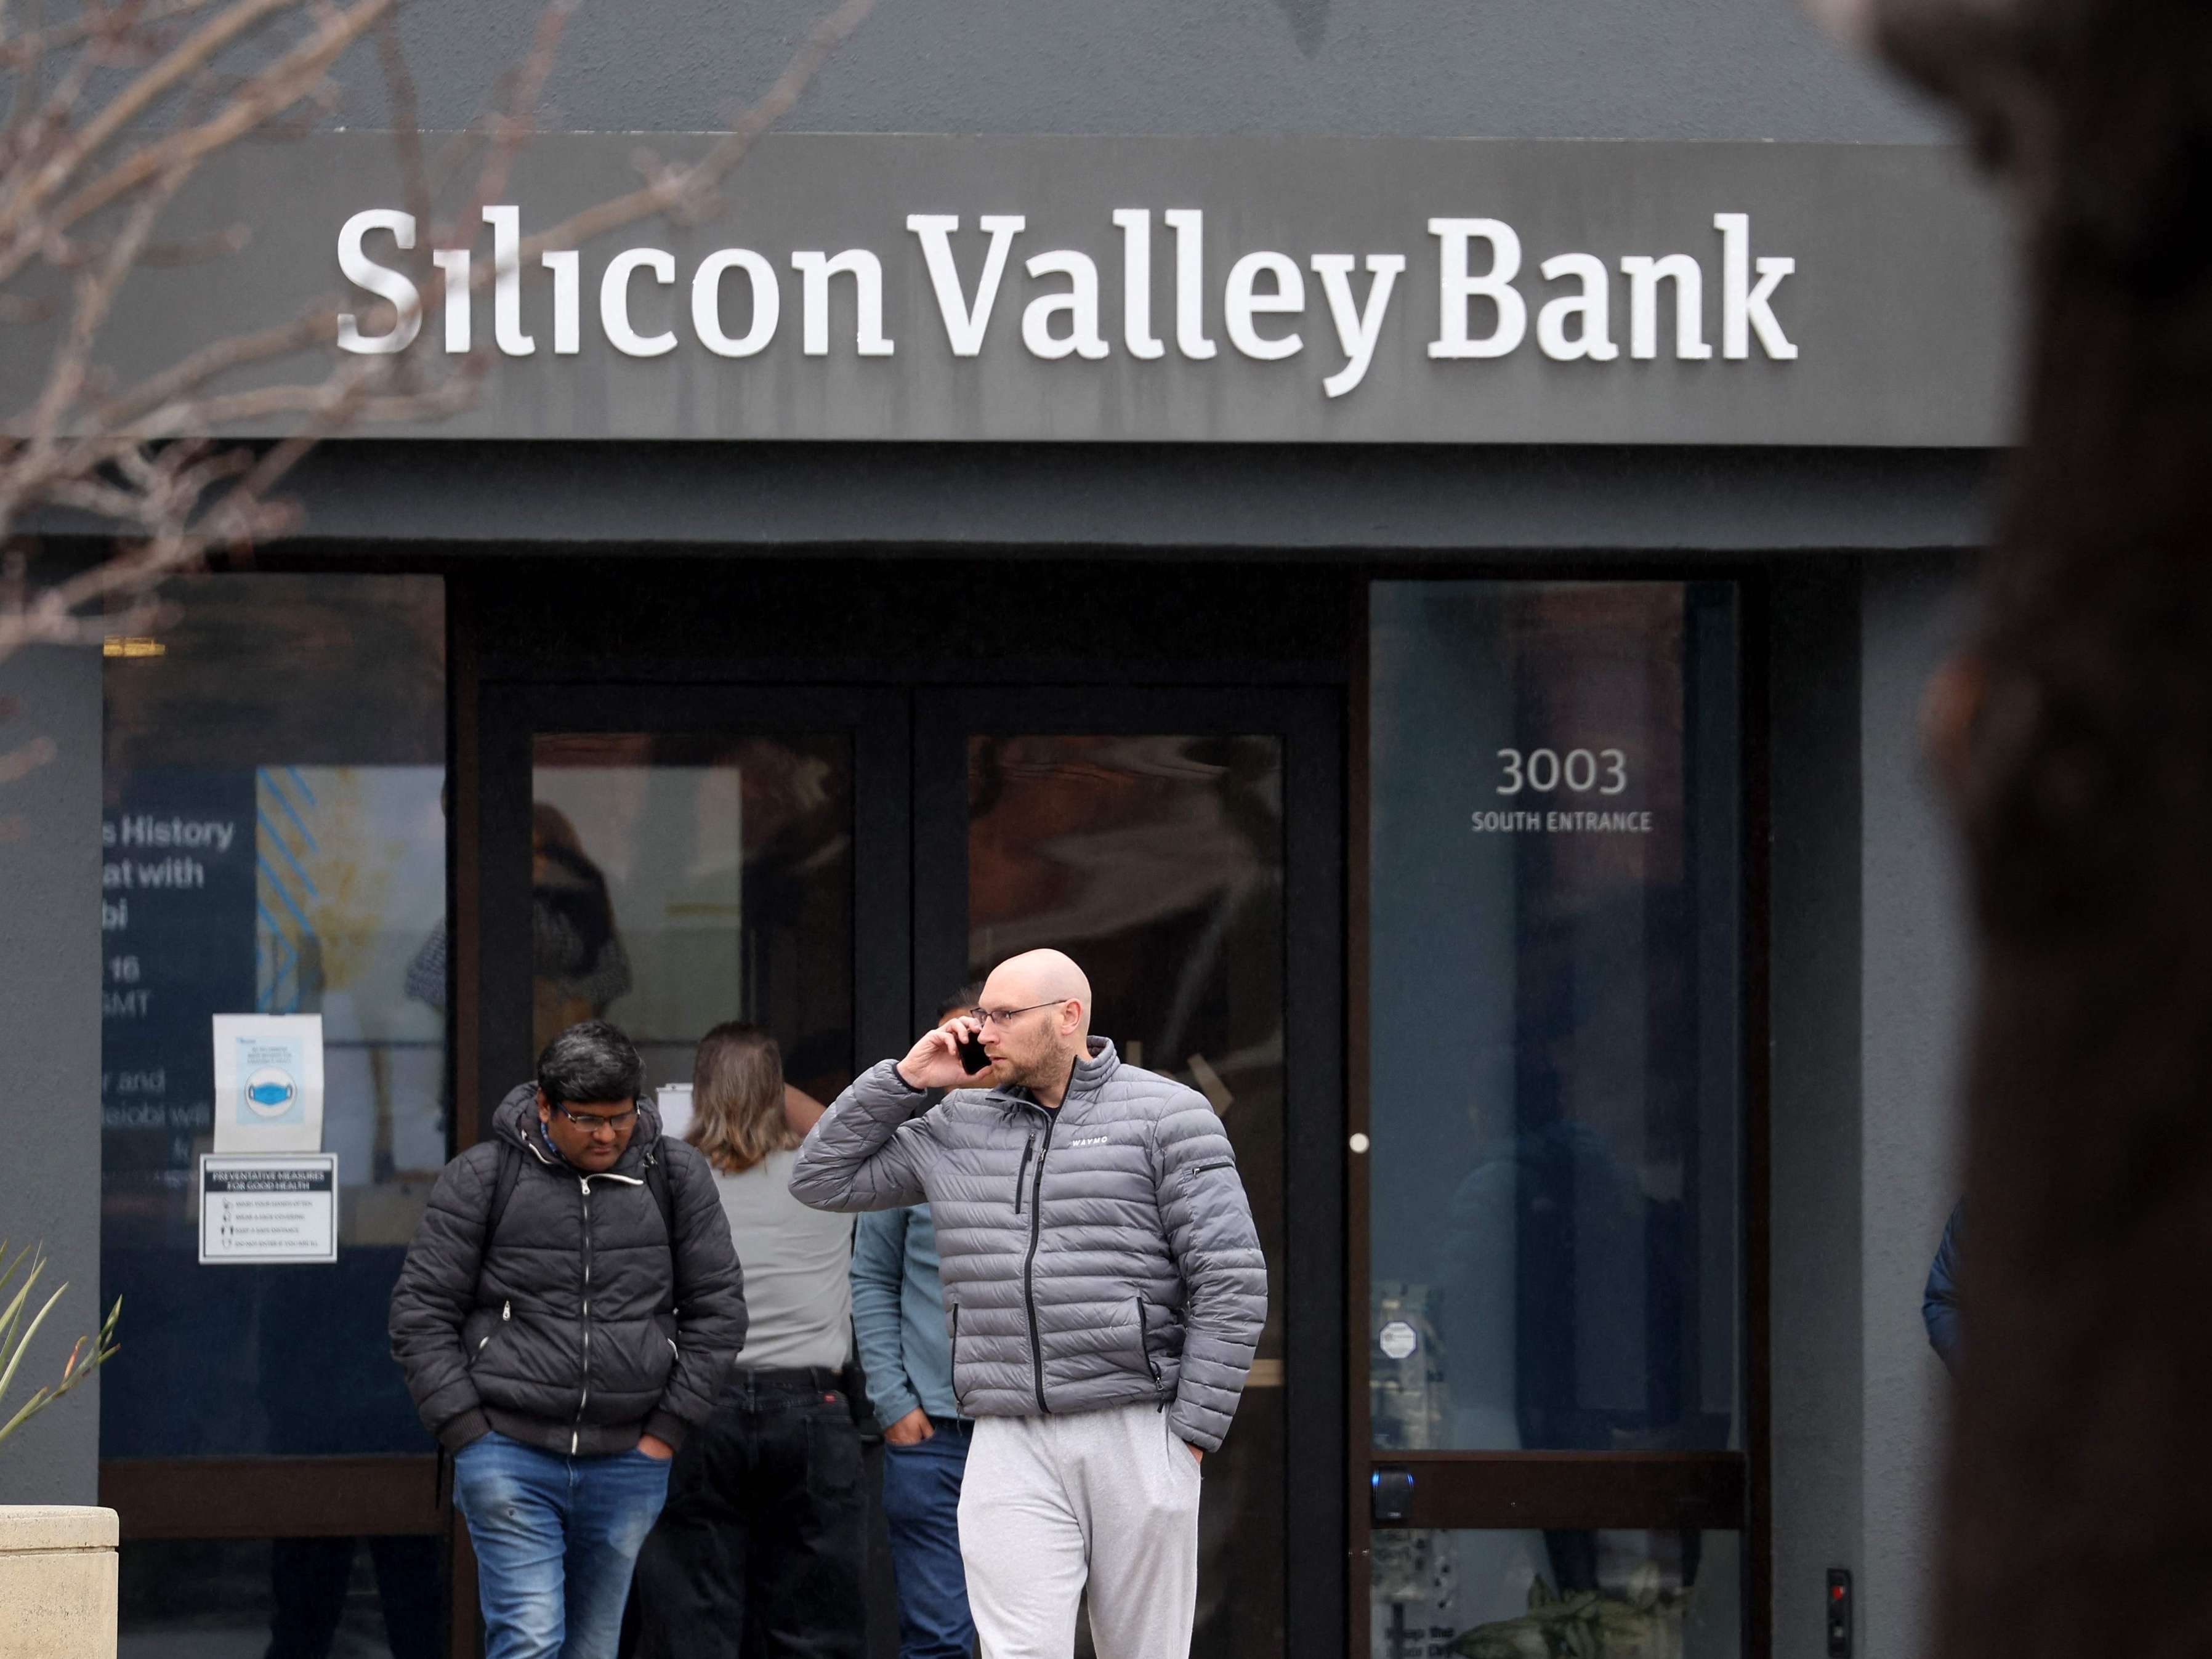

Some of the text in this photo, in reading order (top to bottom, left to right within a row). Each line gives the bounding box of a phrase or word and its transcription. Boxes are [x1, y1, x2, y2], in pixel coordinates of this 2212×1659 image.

[337, 205, 1798, 398] Silicon Valley Bank
[1496, 748, 1628, 796] 3003
[121, 813, 235, 854] History
[1471, 811, 1653, 832] SOUTH ENTRANCE
[138, 856, 204, 889] with
[118, 1067, 165, 1094] and
[1072, 1136, 1107, 1146] WAYMO
[212, 1171, 325, 1181] PREVENTATIVE MEASURES
[227, 1181, 310, 1190] FOR GOOD HEALTH
